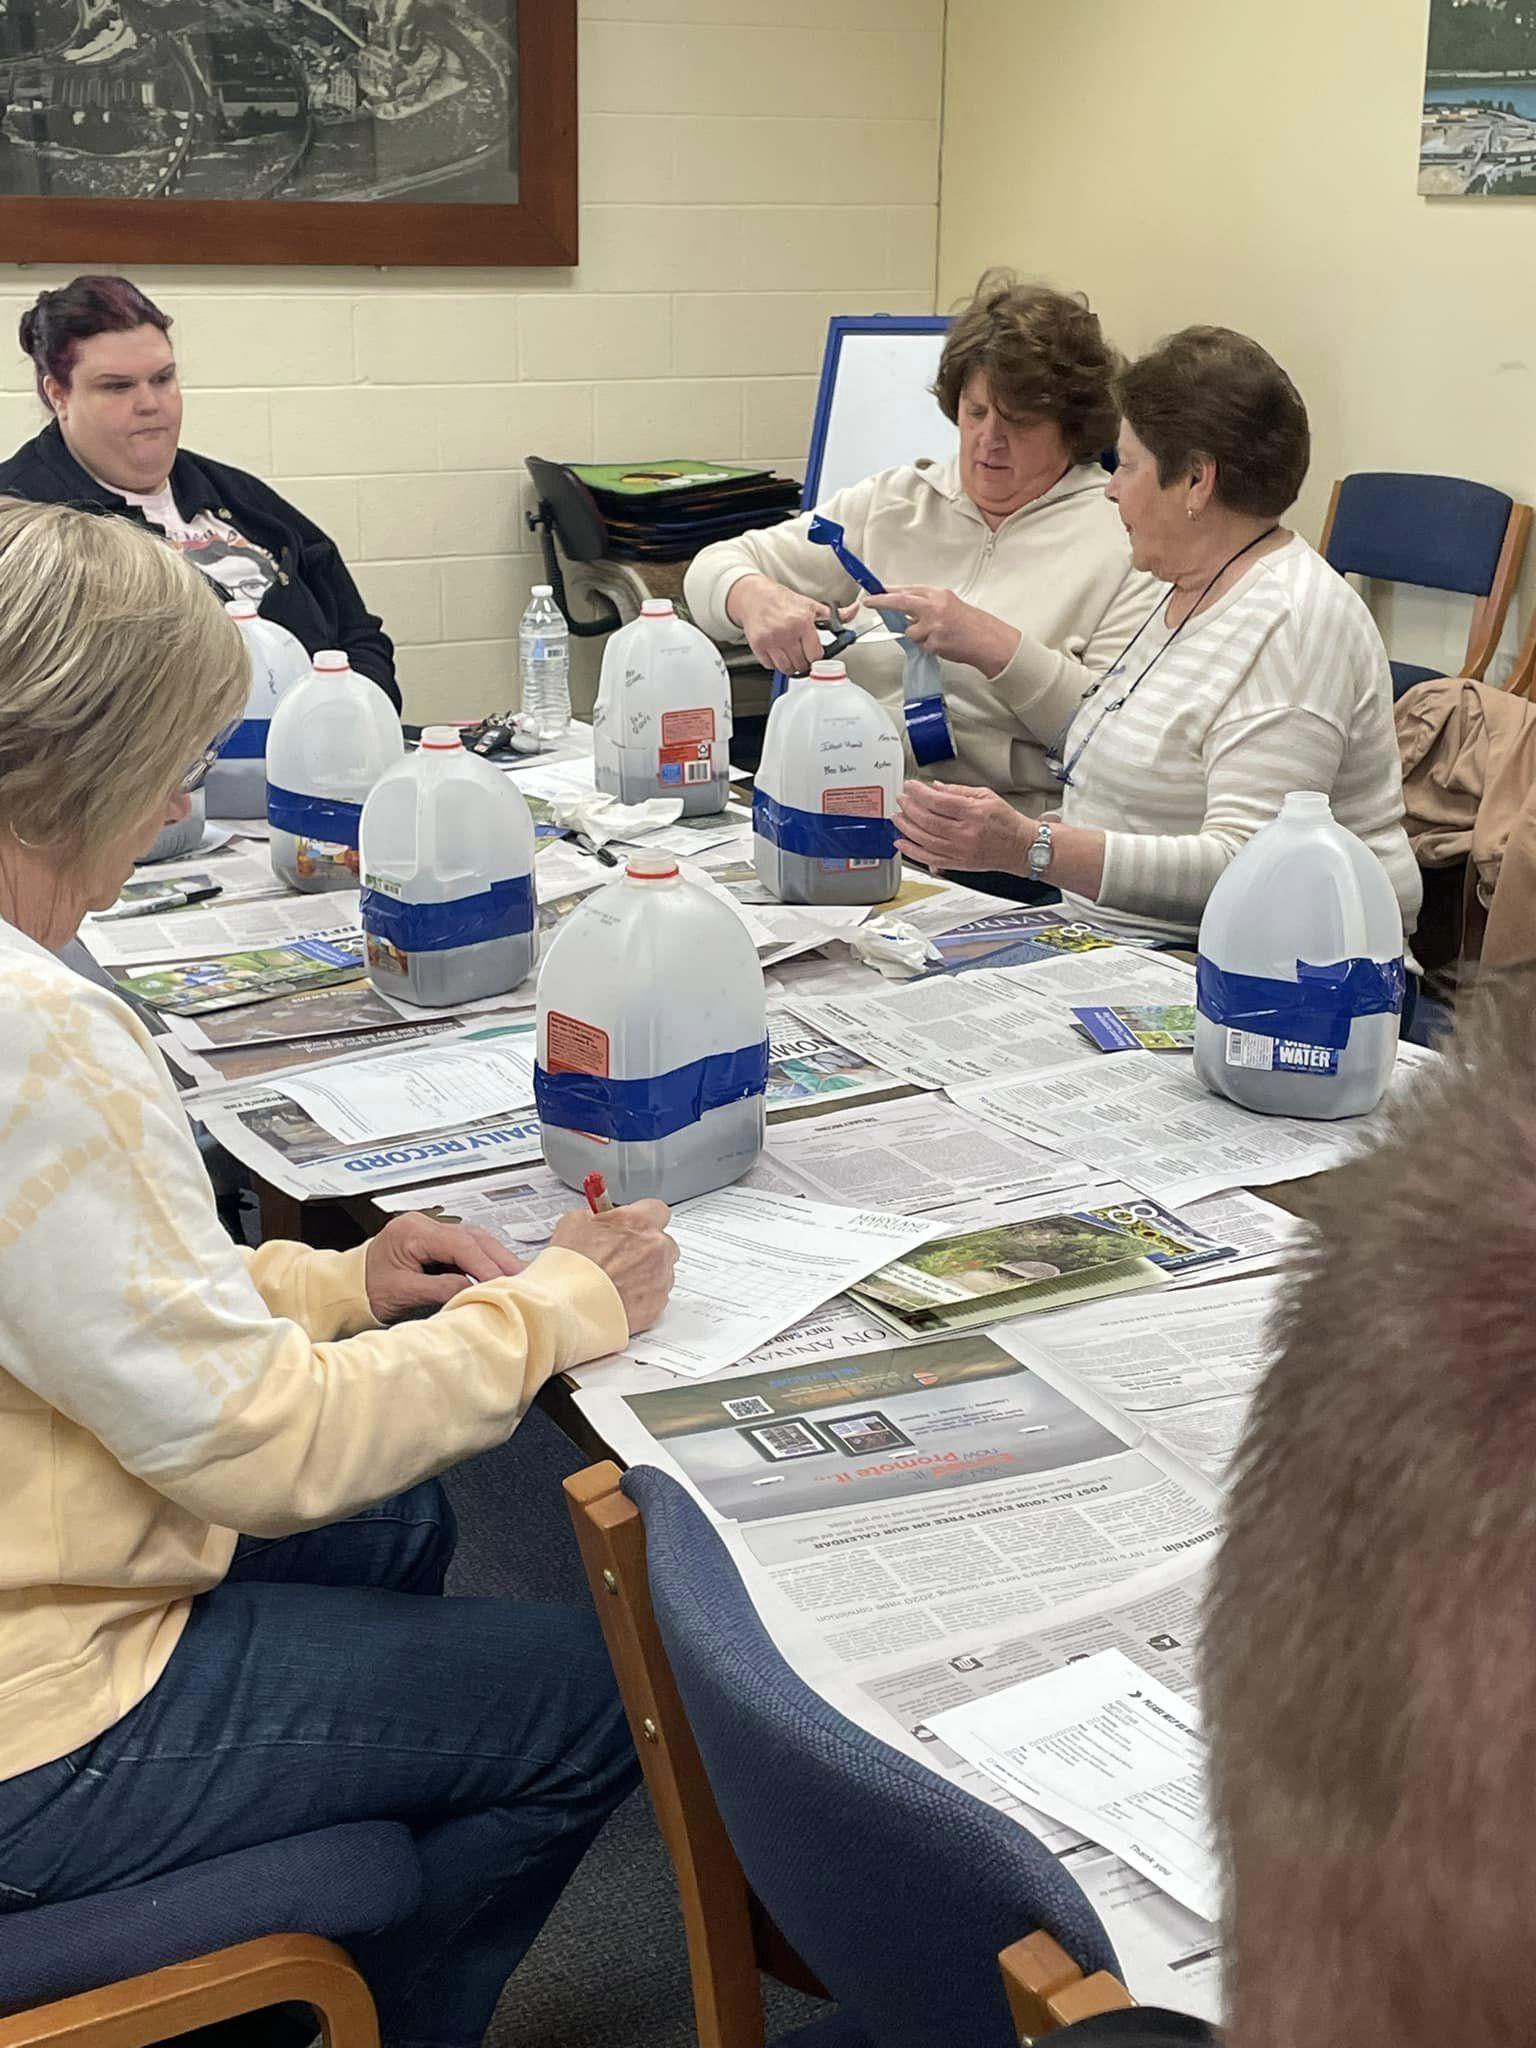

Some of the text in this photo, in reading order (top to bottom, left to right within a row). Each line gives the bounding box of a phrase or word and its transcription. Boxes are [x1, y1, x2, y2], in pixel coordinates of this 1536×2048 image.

[955, 912, 1053, 933] URNAL
[1280, 1047, 1330, 1068] WATER
[344, 1119, 540, 1173] DAILY RECORD
[775, 1325, 834, 1344] THEY SAID
[840, 1327, 887, 1347] ON
[857, 1452, 958, 1479] Promote
[813, 1483, 1108, 1550] POST ALL YOUR EVENTS FREE ON OUR CALENDAR
[1022, 1565, 1067, 1578] appears
[1070, 1559, 1098, 1570] court
[876, 1599, 901, 1611] rape
[903, 1594, 935, 1606] 2020
[815, 1605, 874, 1623] conviction
[1130, 1844, 1172, 1876] Thank you
